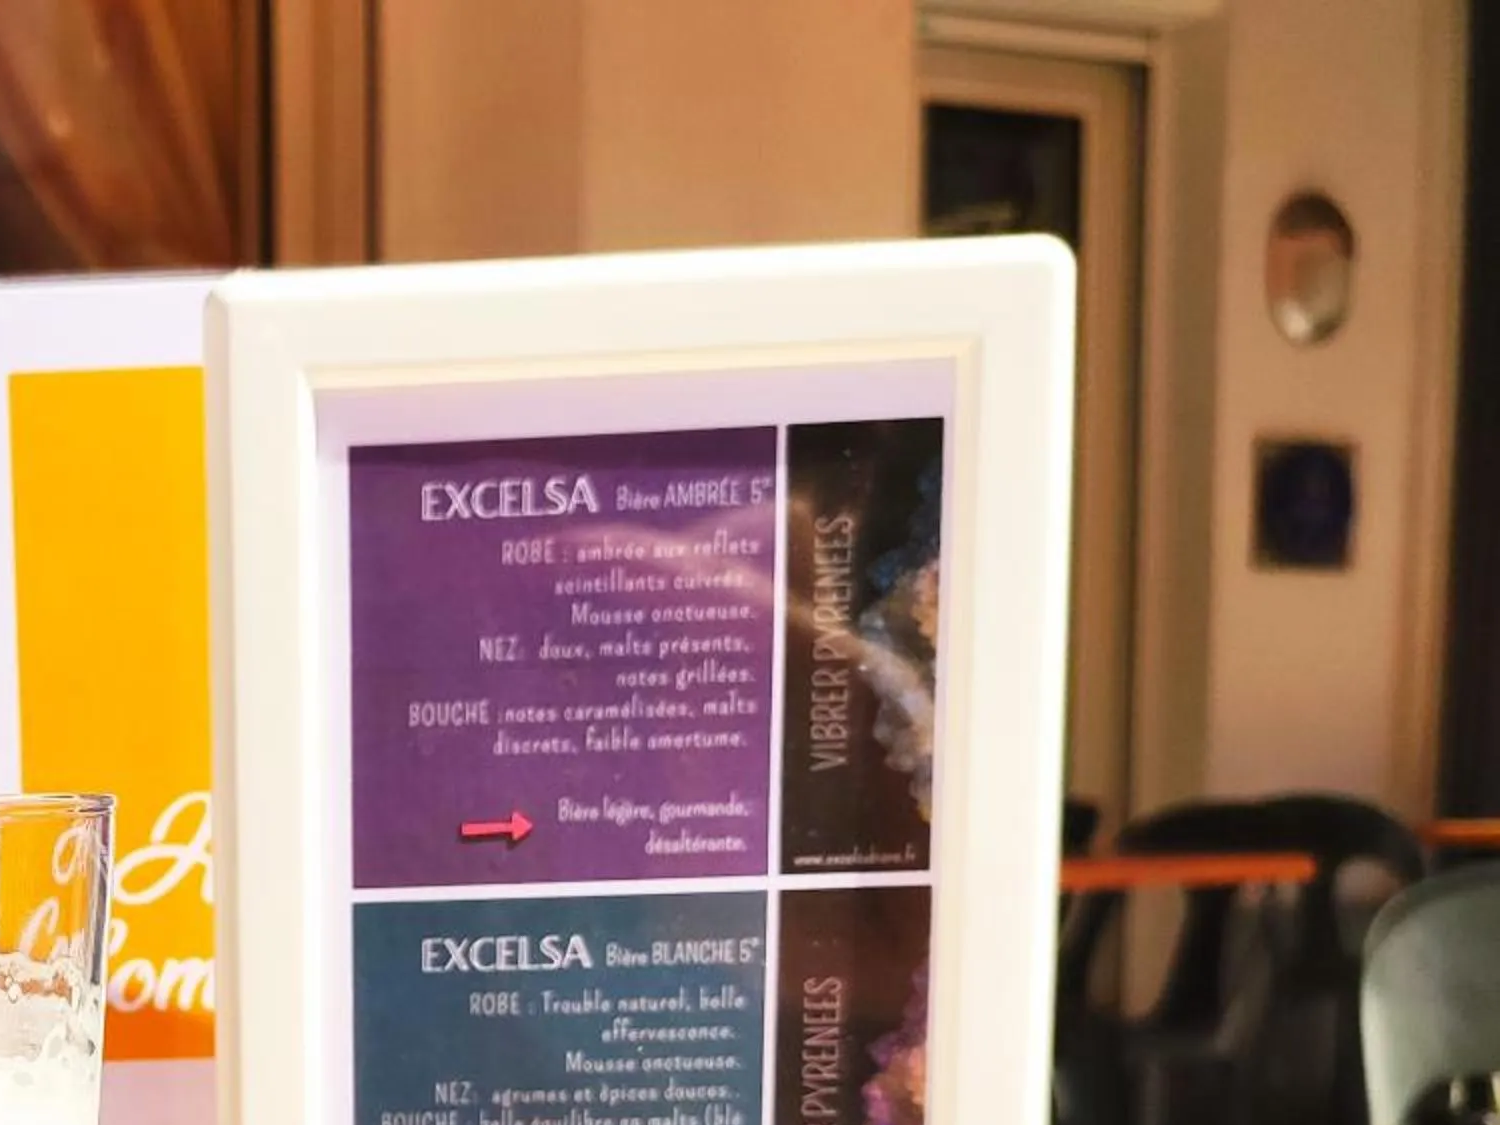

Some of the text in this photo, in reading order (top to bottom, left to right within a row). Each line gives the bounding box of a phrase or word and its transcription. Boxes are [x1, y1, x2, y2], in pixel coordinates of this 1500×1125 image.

[421, 474, 598, 521] EXCELSA
[663, 476, 741, 508] AMBRÉE
[502, 539, 555, 566] ROBE
[577, 535, 644, 563] ambrée
[653, 544, 687, 559] aux
[694, 528, 760, 556] reflets
[555, 568, 666, 596] scintillants
[571, 602, 754, 626] Mousse onctueuse.
[539, 635, 591, 660] doux,
[600, 630, 652, 657] malts
[616, 659, 755, 691] notes grillées.
[409, 700, 489, 728] BOUCHE
[703, 690, 758, 716] malts
[809, 669, 849, 772] VIBRER
[493, 725, 748, 755] discrets, faible amertume.
[558, 797, 598, 822] Bière
[421, 934, 594, 972] EXCELSA
[606, 941, 648, 967] Bière
[652, 938, 734, 966] BLANCHE
[469, 991, 521, 1016] ROBE
[541, 988, 610, 1014] Trouble
[700, 983, 746, 1009] belle
[601, 1017, 736, 1042] effervescence.
[565, 1050, 741, 1073] Mousse onctueuse.
[492, 1088, 567, 1107] agrumes
[573, 1086, 593, 1102] et
[599, 1082, 659, 1107] épices
